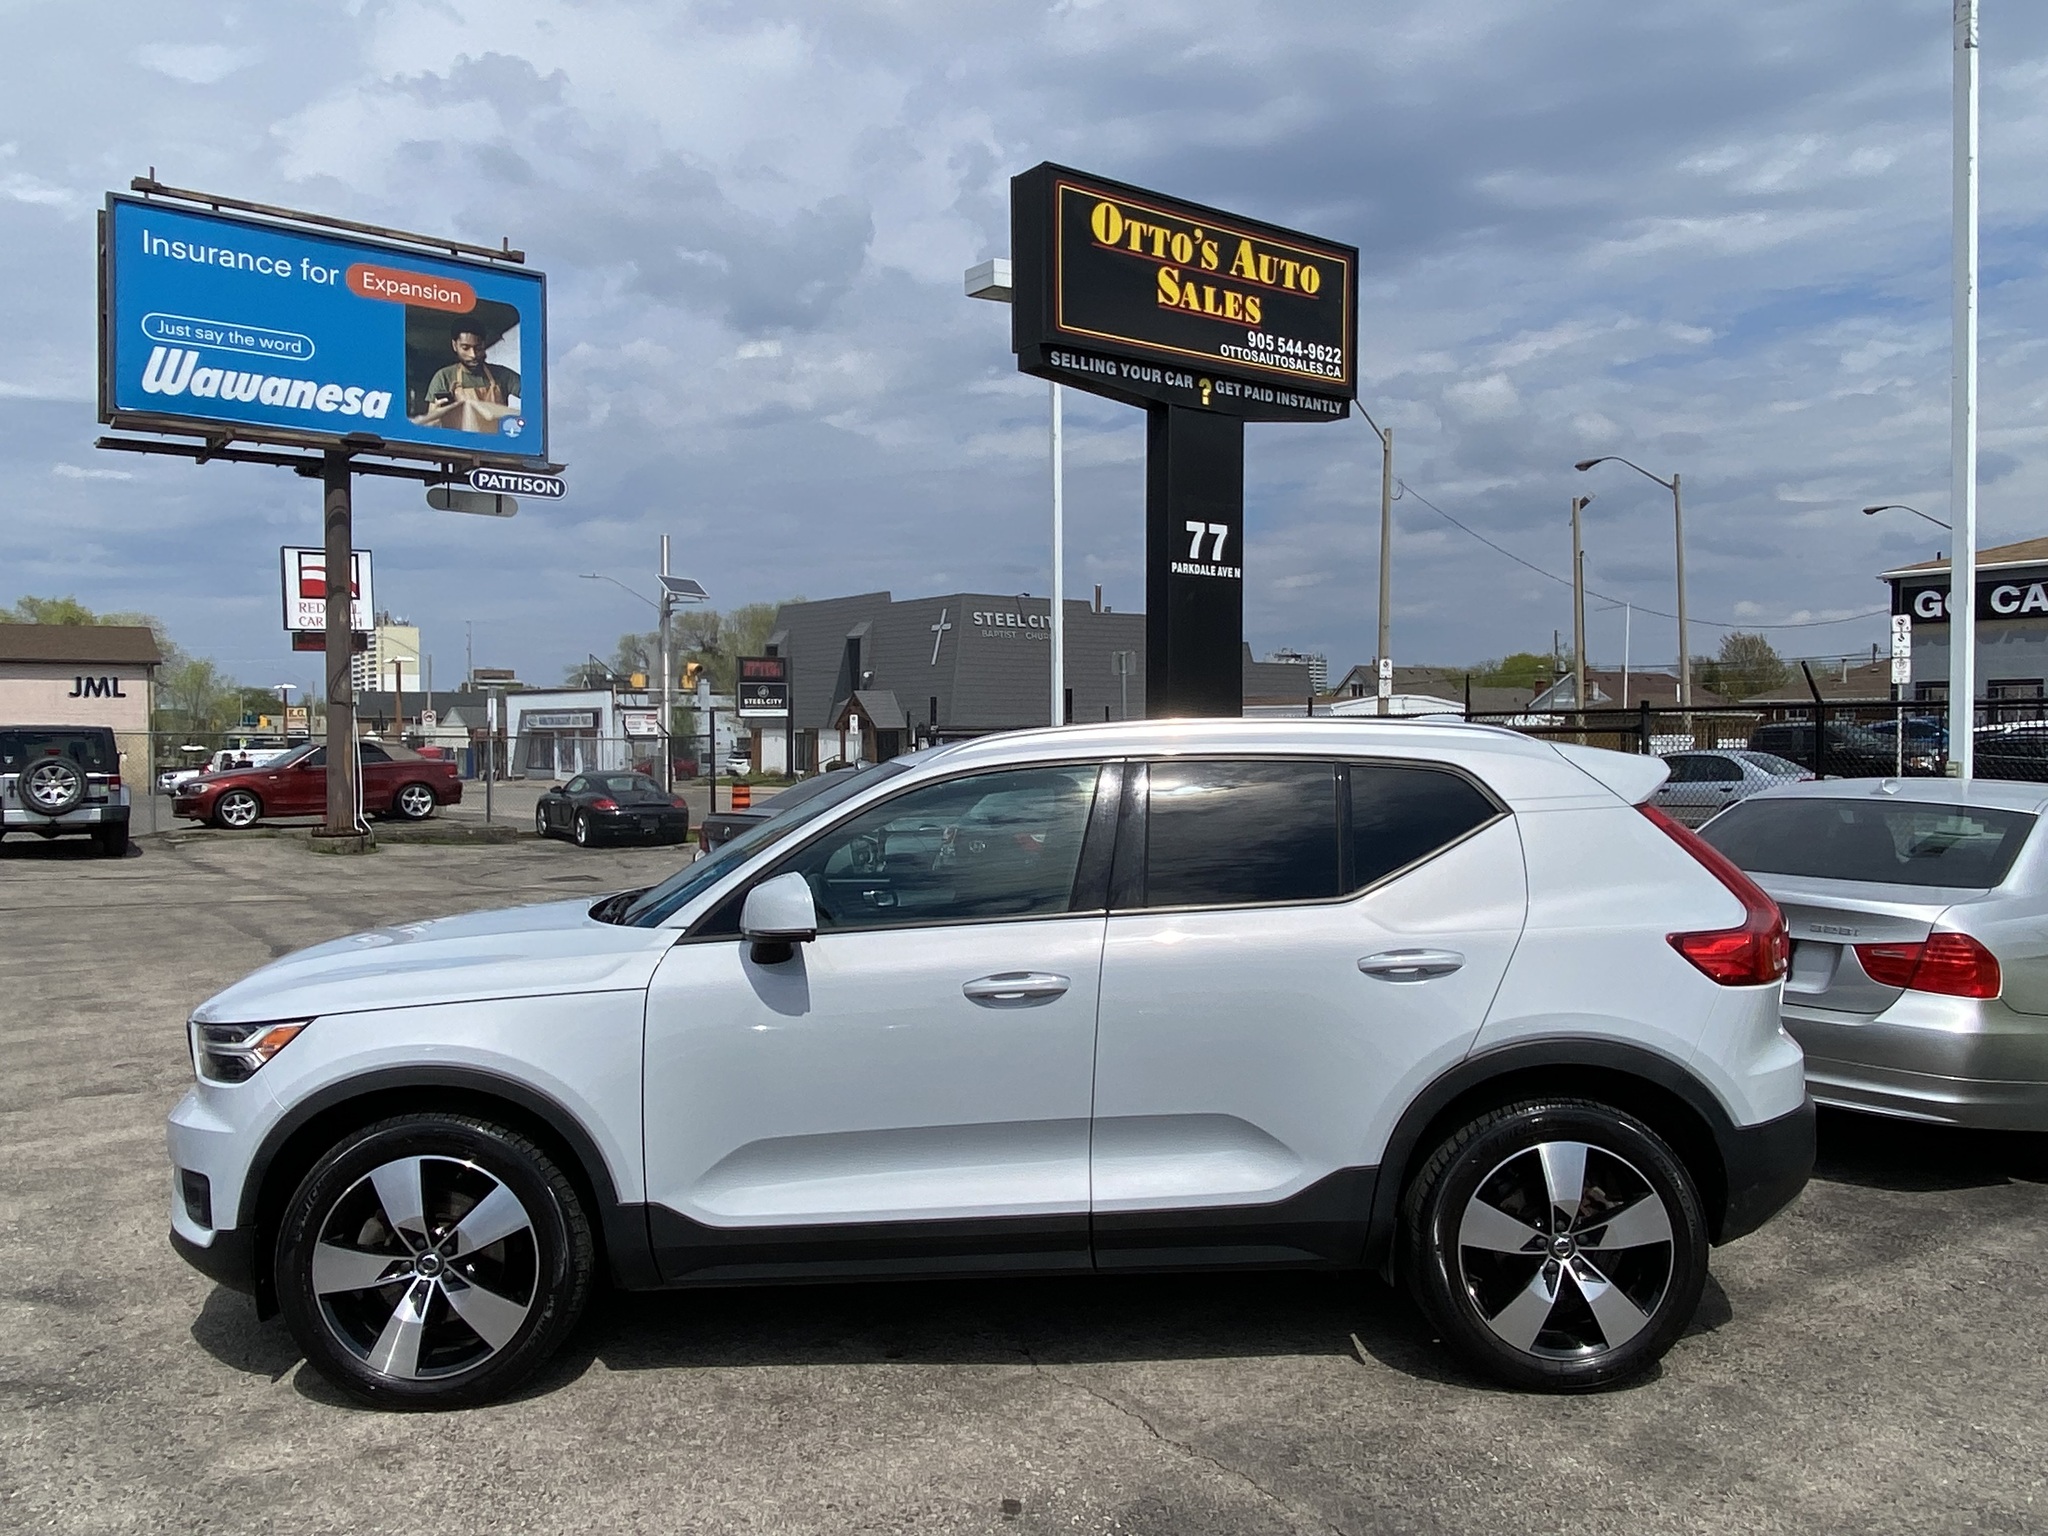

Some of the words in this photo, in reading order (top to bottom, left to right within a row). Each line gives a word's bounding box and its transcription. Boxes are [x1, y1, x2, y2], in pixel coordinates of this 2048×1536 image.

[142, 229, 292, 277] Insurance
[300, 257, 339, 285] for
[1230, 238, 1321, 294] AUTO
[362, 272, 462, 305] Expansion
[1157, 265, 1261, 324] SALES
[156, 319, 191, 338] Just
[195, 325, 224, 346] say
[228, 325, 255, 347] the
[259, 333, 302, 354] word
[1247, 331, 1274, 352] 905
[1278, 334, 1341, 364] 544-9622
[1220, 344, 1341, 378] OTTOSAUTOSALES.CA
[142, 346, 392, 419] Wawanesa
[1050, 351, 1117, 376] SELLING
[1120, 363, 1162, 383] YOUR
[1165, 370, 1193, 389] CAR
[1215, 381, 1242, 398] GET
[1244, 386, 1273, 402] PAID
[1276, 391, 1343, 415] INSTANTLY
[478, 473, 560, 495] PATTISON
[1186, 521, 1228, 561] 77
[1171, 562, 1216, 577] PARKDALE
[1217, 566, 1234, 578] AVE
[1234, 567, 1241, 578] N
[299, 602, 326, 614] RED
[1914, 590, 1952, 618] G
[299, 616, 324, 627] CAR
[982, 629, 1017, 639] BAPTIST
[68, 676, 126, 698] JML
